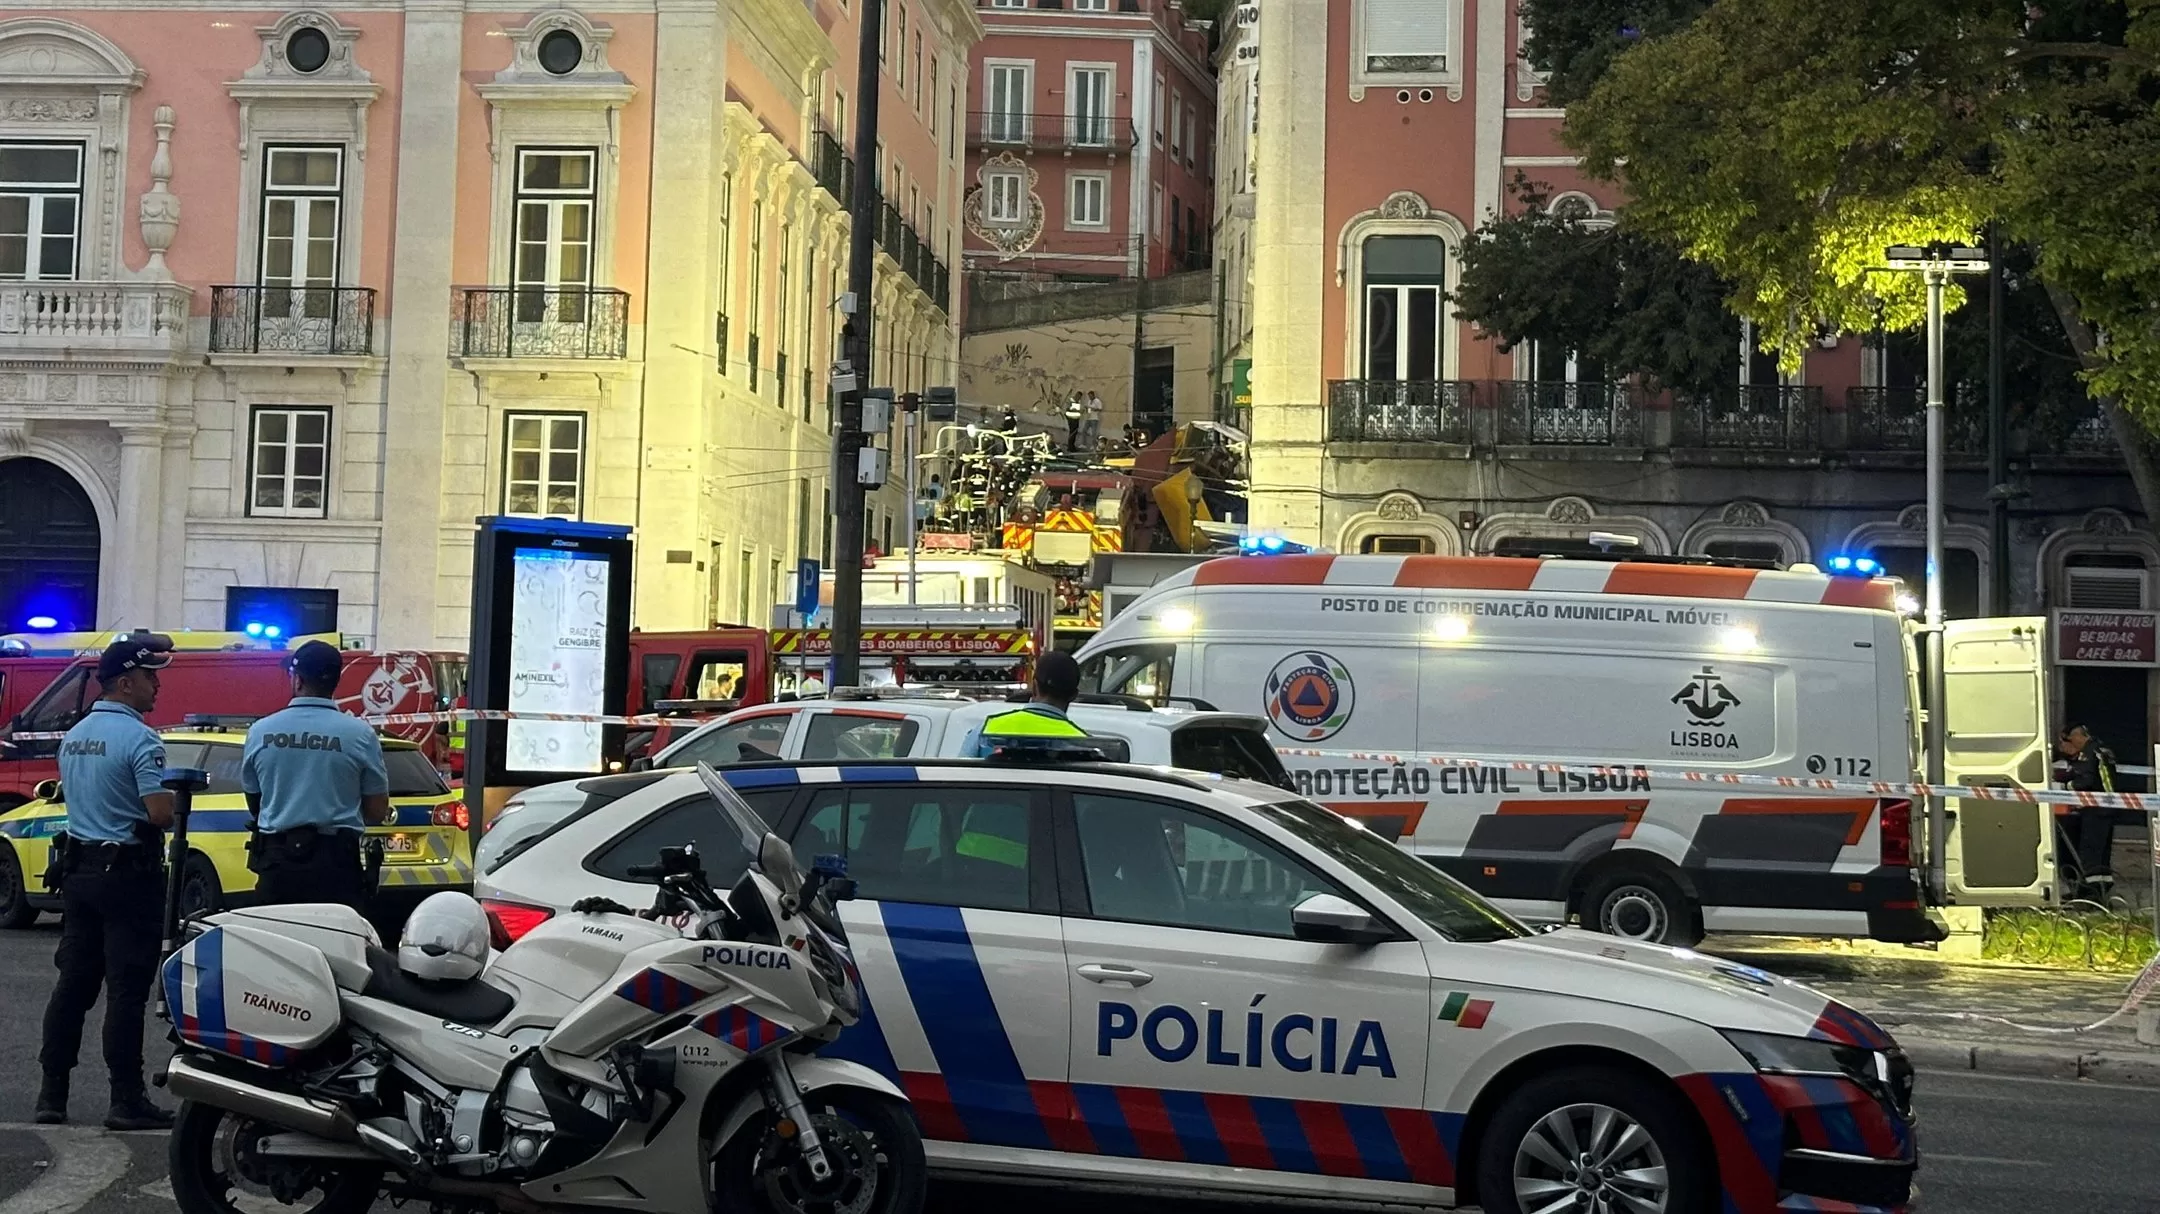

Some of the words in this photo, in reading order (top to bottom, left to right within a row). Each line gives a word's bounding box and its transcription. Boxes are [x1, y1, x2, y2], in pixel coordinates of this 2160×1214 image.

[803, 563, 814, 597] P
[1321, 598, 1379, 613] POSTO
[1384, 599, 1407, 614] DE
[1413, 600, 1548, 618] COORDENAÇÃO
[1554, 605, 1659, 623] MUNICIPAL
[1666, 607, 1731, 627] MÓVEL
[559, 638, 601, 648] GENGIBRE
[878, 640, 951, 650] BOMBEIROS
[955, 641, 1001, 650] LISBOA
[2079, 631, 2136, 643] BEBIDAS
[2076, 646, 2111, 659] CAFÉ
[2114, 648, 2142, 660] BAR
[514, 672, 556, 683] AMINEXIL
[63, 738, 107, 757] POLÍCIA
[263, 732, 342, 752] POLÍCIA
[1670, 731, 1739, 749] LISBOA
[1833, 757, 1872, 777] 112
[1287, 762, 1430, 799] ROTEÇÃO
[1440, 765, 1520, 793] CIVIL
[581, 925, 624, 942] YAMAHA
[702, 945, 792, 970] POLÍCIA
[243, 991, 312, 1022] TRÂNSITO
[1097, 993, 1397, 1079] POLÍCIA
[690, 1046, 709, 1056] 112
